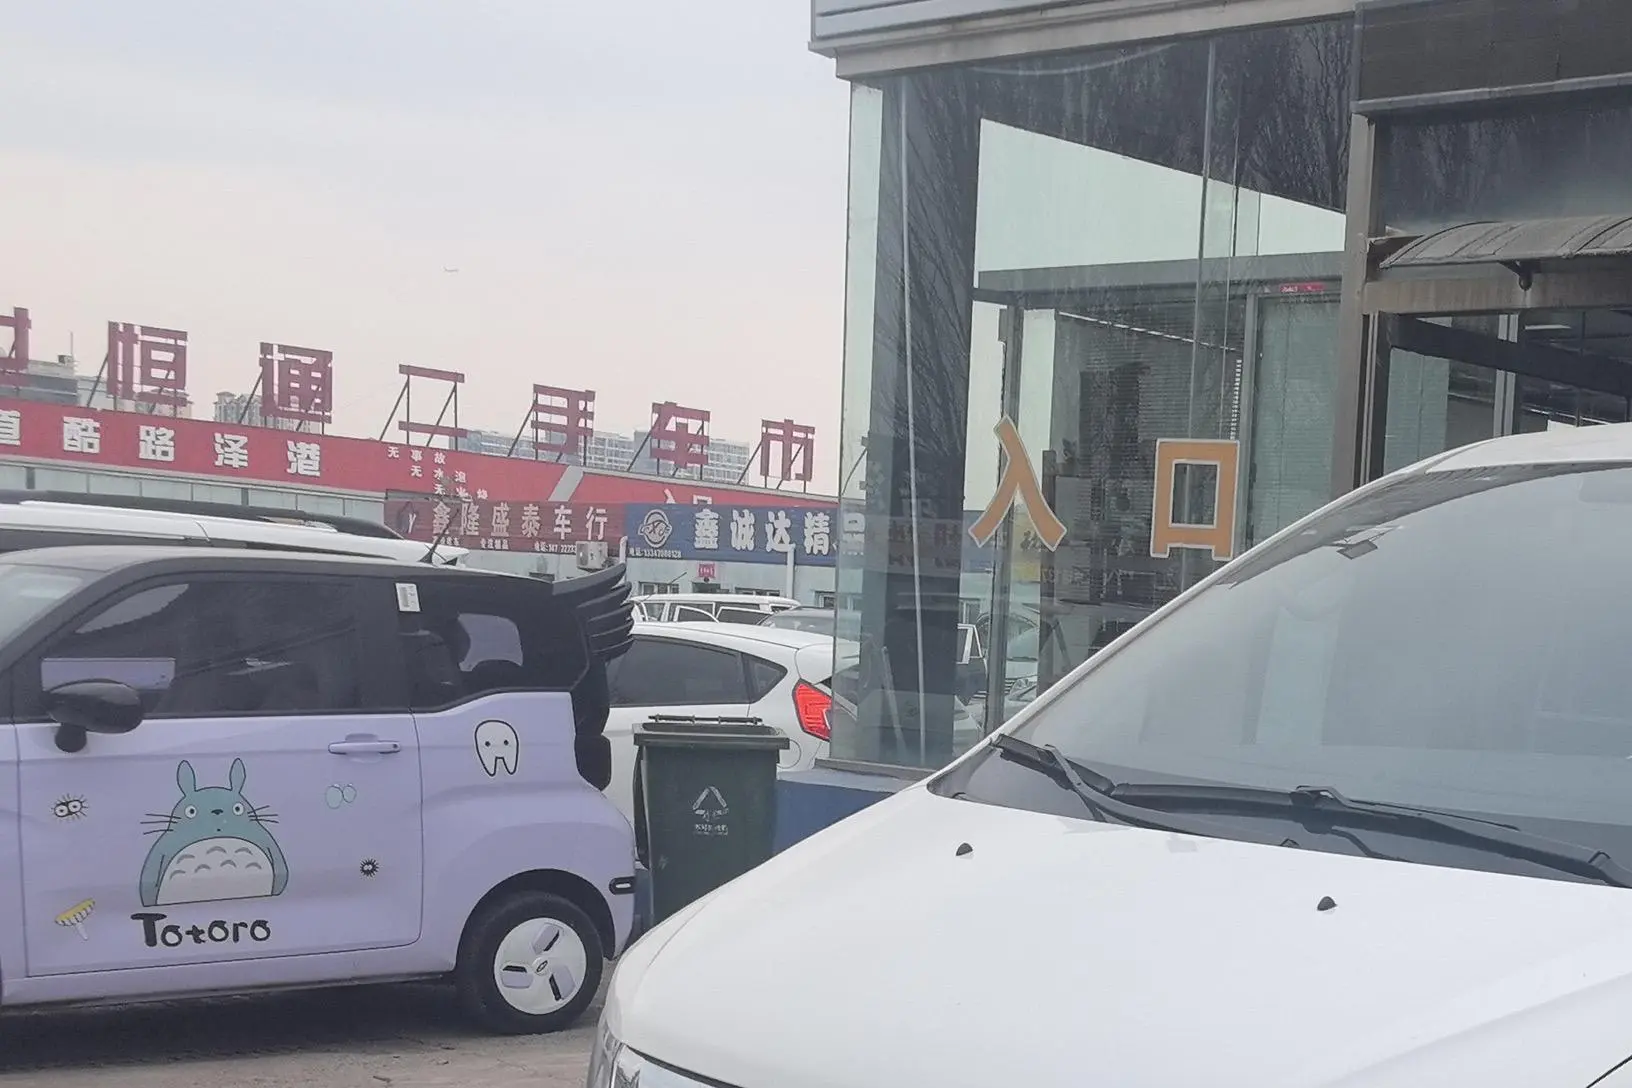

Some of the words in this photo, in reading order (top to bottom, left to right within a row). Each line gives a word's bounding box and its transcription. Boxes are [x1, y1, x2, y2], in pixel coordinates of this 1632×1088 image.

[966, 413, 1241, 560] 入口
[432, 498, 609, 541] 鑫隆盛泰车行
[131, 911, 272, 949] Totoro
